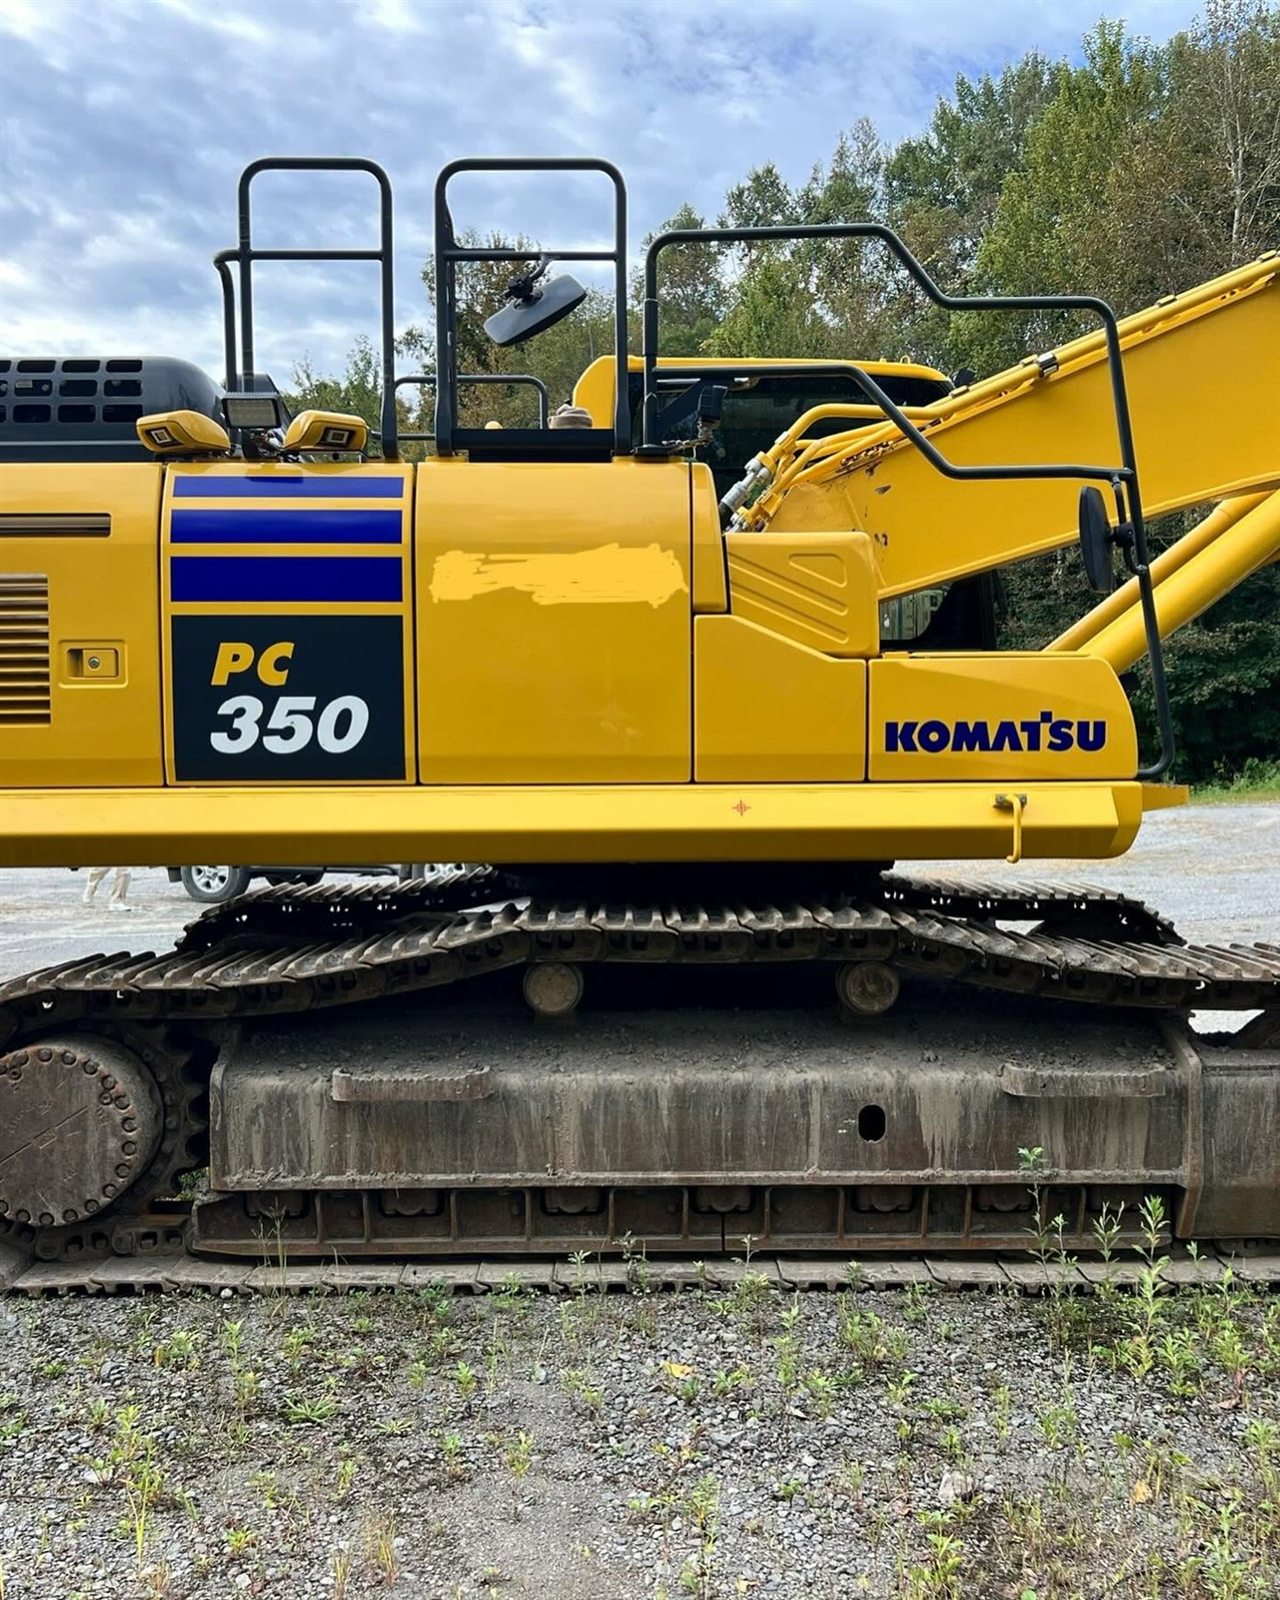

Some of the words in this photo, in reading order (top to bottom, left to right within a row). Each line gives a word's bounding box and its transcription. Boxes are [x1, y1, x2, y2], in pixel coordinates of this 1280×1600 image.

[211, 642, 295, 686] PC
[210, 695, 369, 754] 350
[885, 711, 1106, 753] KOMATSU
